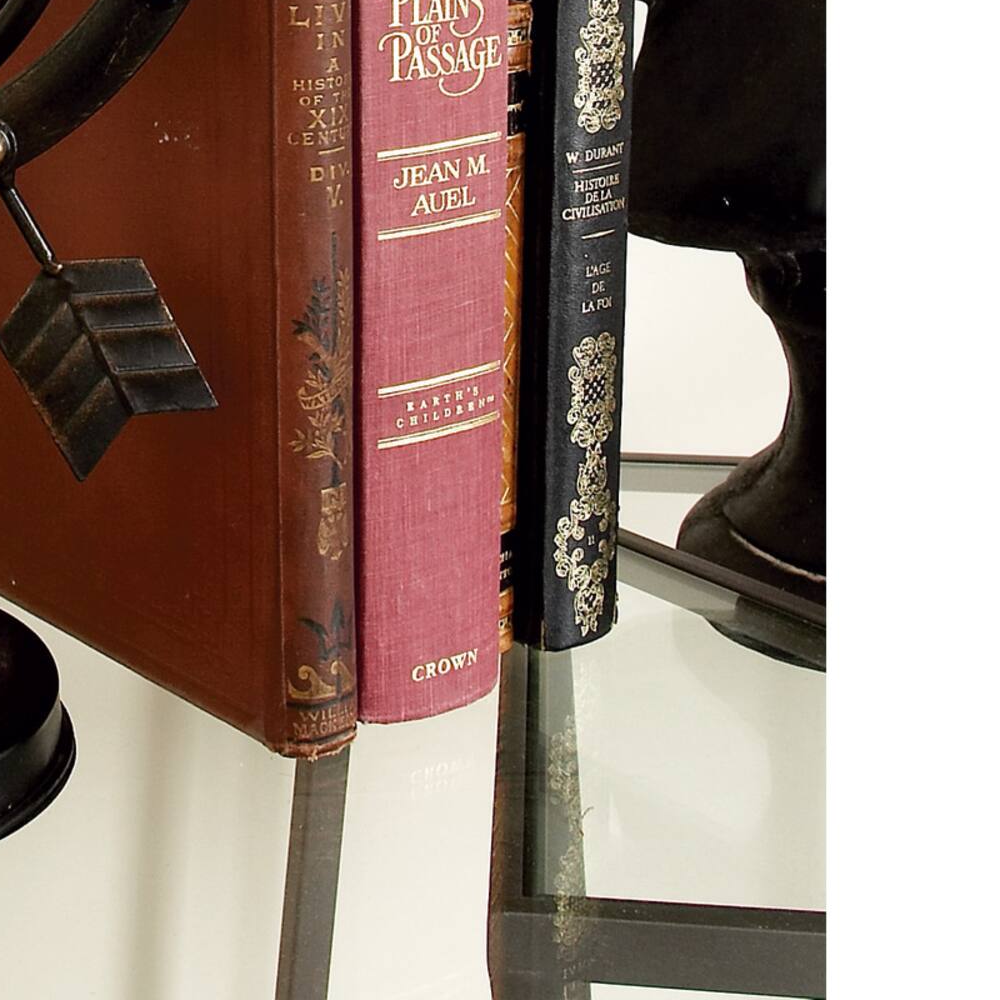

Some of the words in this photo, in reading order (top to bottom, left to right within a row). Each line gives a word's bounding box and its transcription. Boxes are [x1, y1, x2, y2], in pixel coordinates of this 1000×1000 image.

[288, 2, 346, 27] LIV
[316, 29, 345, 50] IN
[416, 24, 442, 46] OF
[326, 57, 340, 73] A
[378, 31, 502, 97] PASSAGE
[293, 74, 346, 91] HISTO
[299, 94, 324, 107] OF
[308, 104, 349, 129] XIX
[585, 141, 624, 162] DURANT
[393, 158, 461, 189] JEAN
[466, 153, 491, 177] M.
[574, 173, 620, 193] HISTOIRE
[410, 185, 476, 217] AUEL
[584, 191, 599, 204] DE
[600, 188, 612, 201] LA
[562, 197, 626, 221] CIVILISATION
[591, 280, 606, 294] DE
[581, 302, 596, 314] LA
[596, 296, 612, 310] FOI
[406, 386, 479, 412] EARTH'S
[411, 647, 479, 683] CROWN
